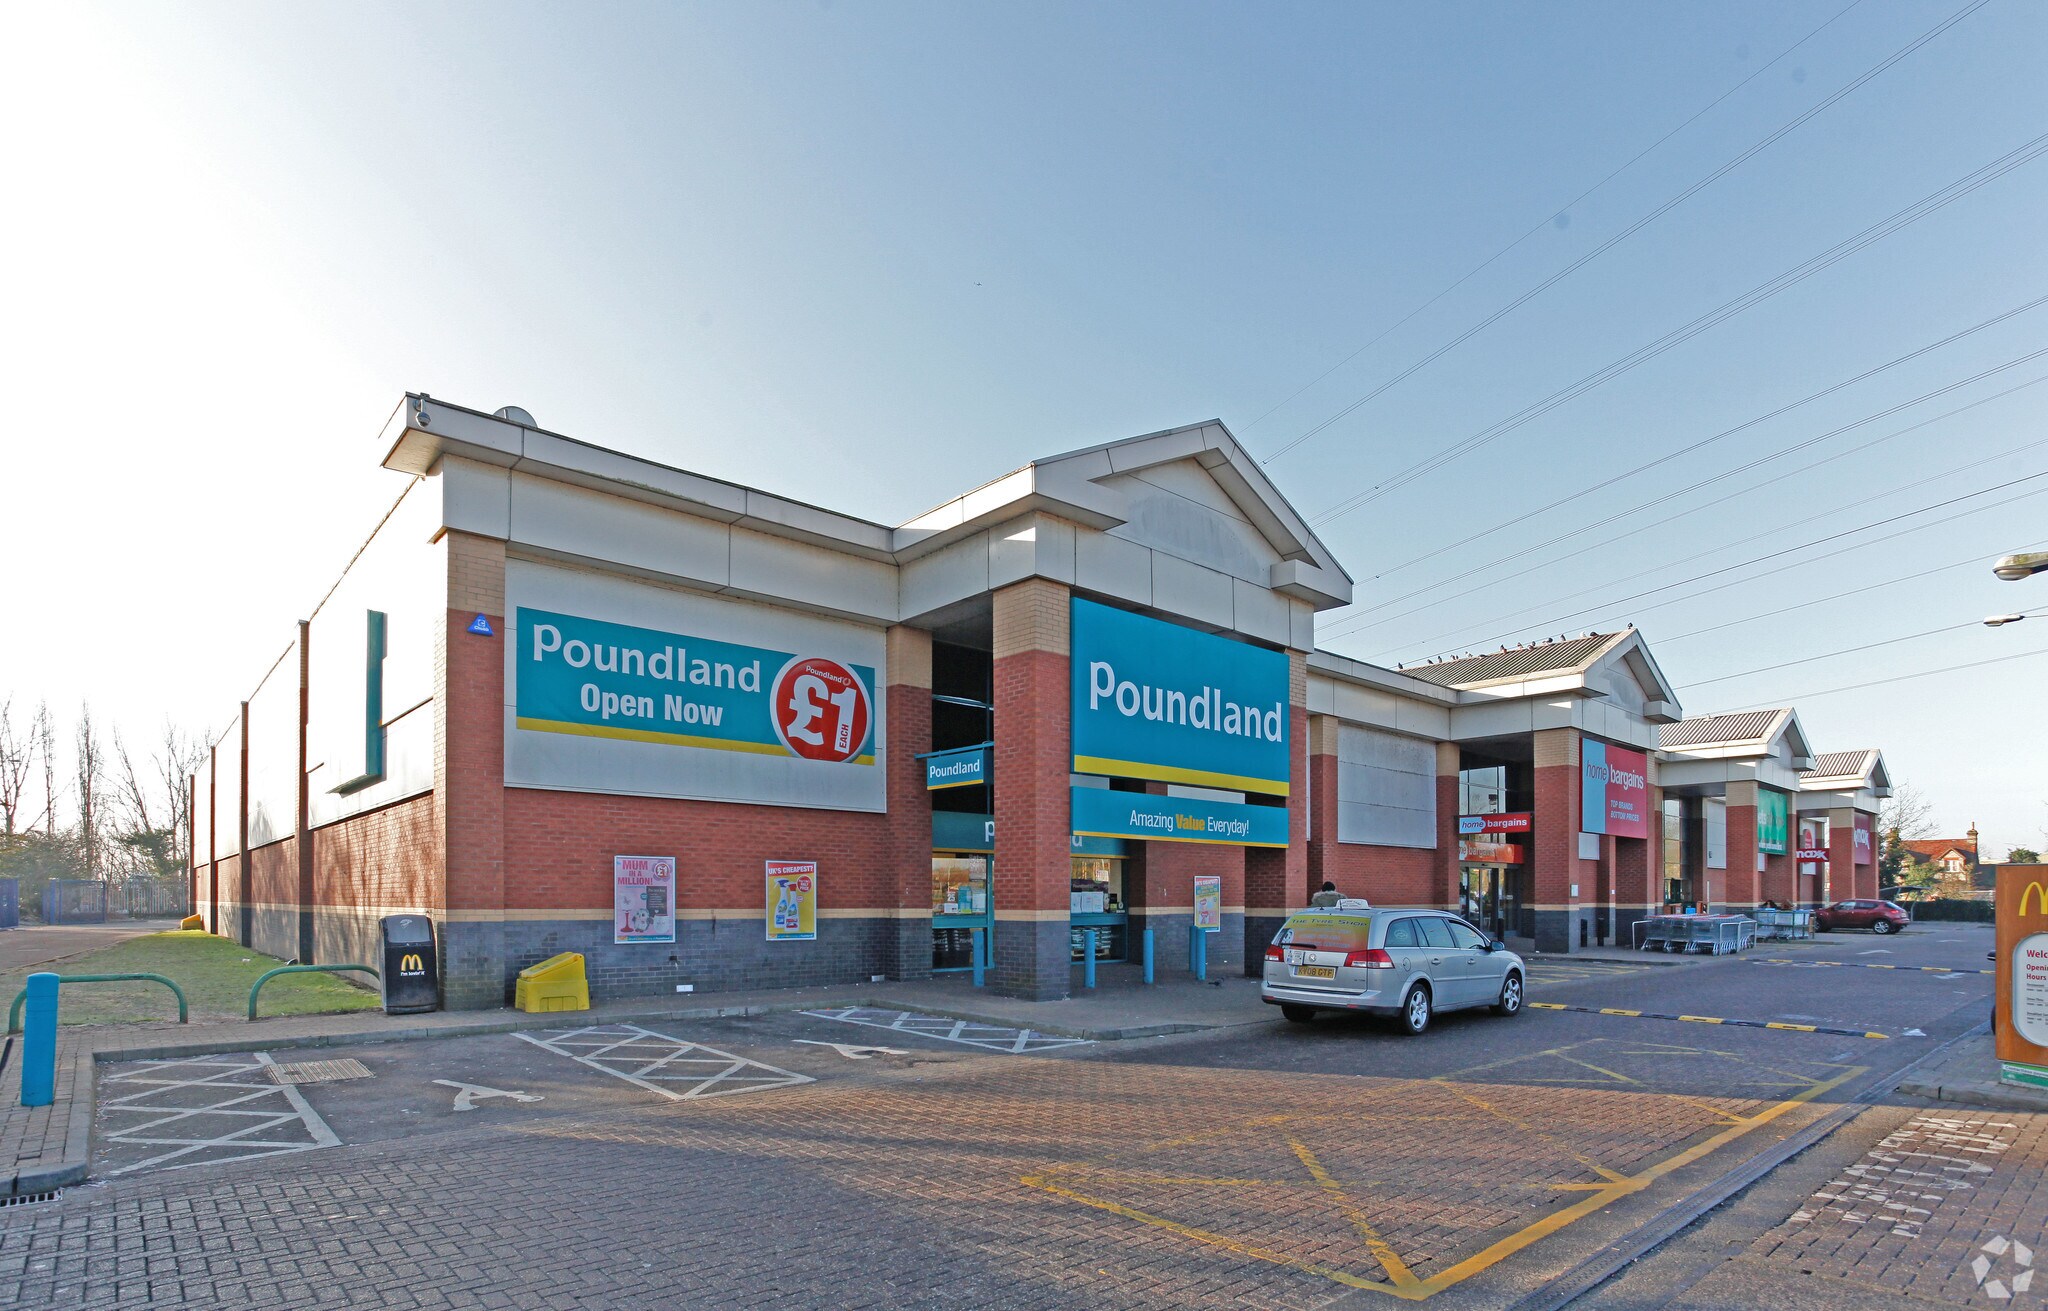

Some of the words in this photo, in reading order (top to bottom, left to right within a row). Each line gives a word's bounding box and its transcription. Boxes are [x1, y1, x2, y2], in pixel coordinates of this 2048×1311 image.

[533, 624, 761, 693] Poundland
[805, 665, 843, 684] Poundland
[580, 683, 654, 720] Open
[664, 694, 724, 727] Now
[1090, 661, 1282, 743] Poundland
[787, 674, 857, 754] £1
[839, 723, 850, 749] EACH
[929, 758, 980, 779] Poundland
[1586, 760, 1608, 782] home
[1610, 764, 1644, 791] bargains
[1129, 810, 1174, 832] Amazing
[1175, 814, 1205, 831] Value
[1207, 816, 1249, 836] Everyday!
[1461, 820, 1484, 829] home
[1487, 818, 1527, 829] bargains
[622, 860, 648, 870] MUM
[768, 867, 782, 875] UK'S
[782, 865, 814, 873] CHEAPEST?
[617, 877, 653, 886] MILLION!
[2026, 963, 2048, 972] Openi
[2026, 973, 2047, 981] Hours
